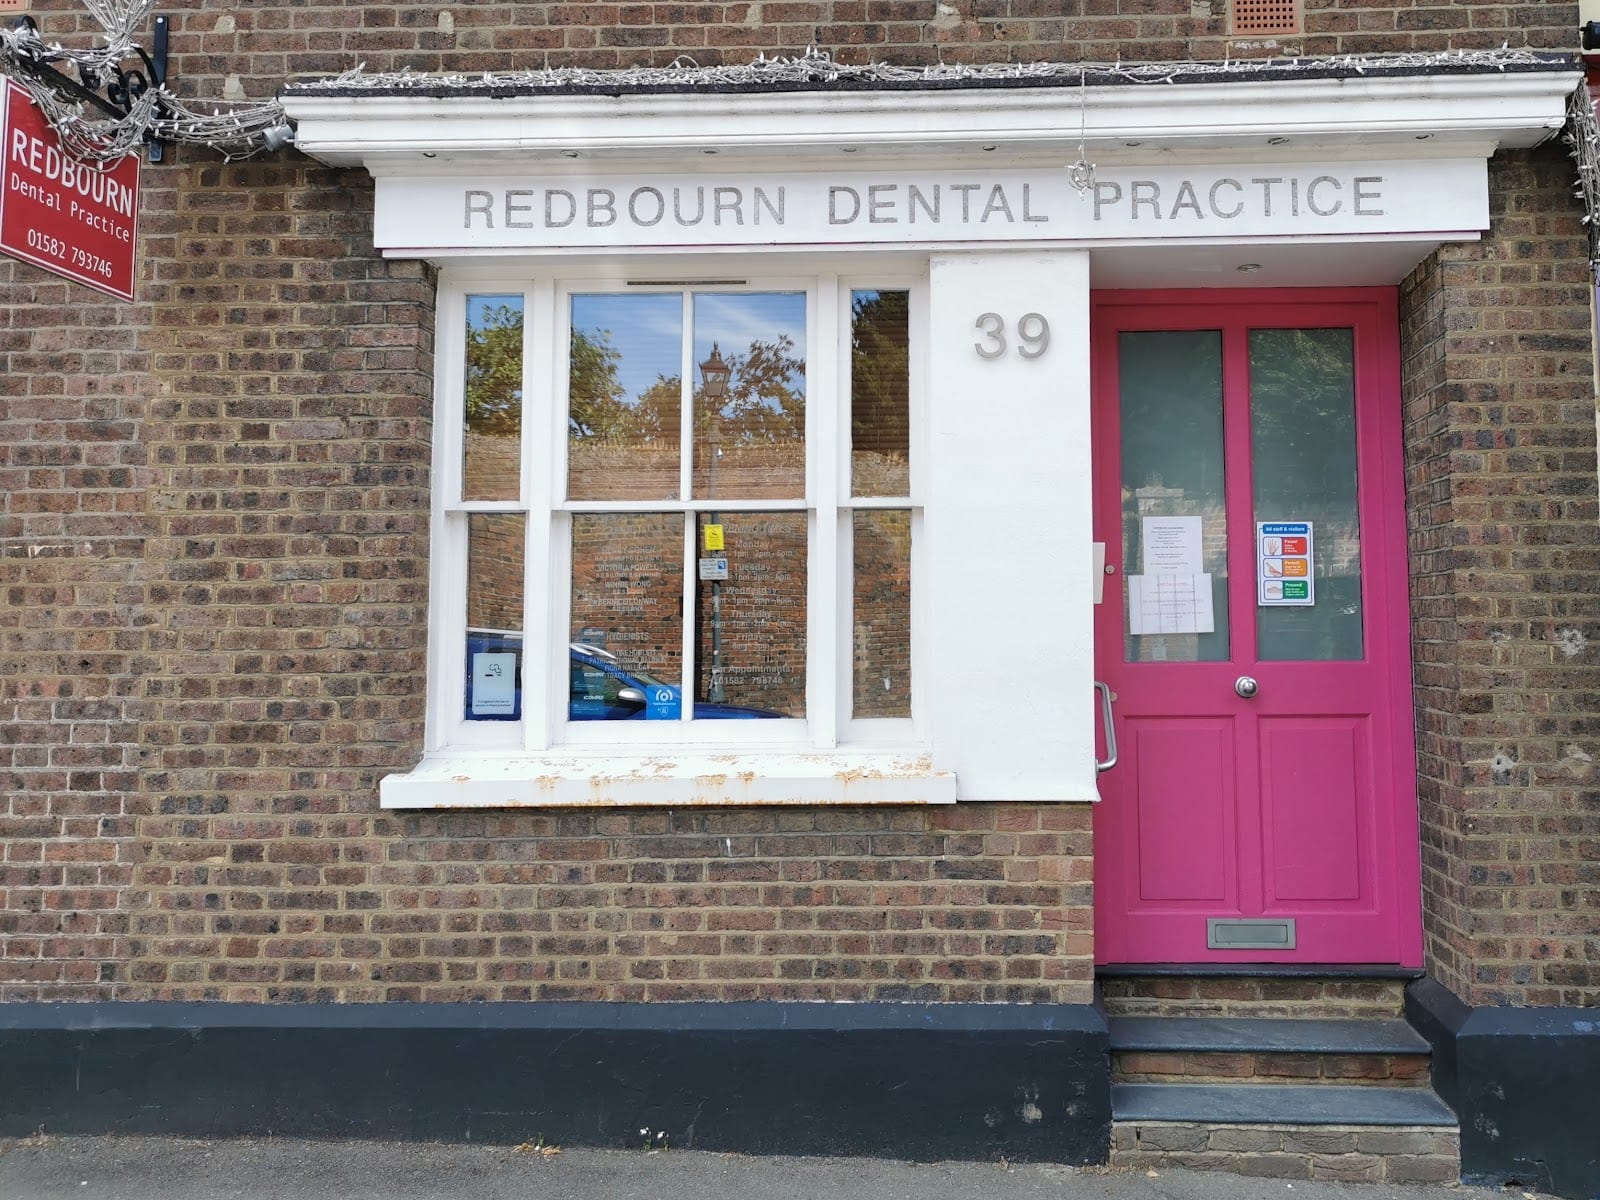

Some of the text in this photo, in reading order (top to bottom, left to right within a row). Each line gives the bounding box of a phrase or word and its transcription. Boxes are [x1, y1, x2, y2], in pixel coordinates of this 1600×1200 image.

[12, 128, 133, 217] REDBOURN
[11, 172, 130, 243] Dental Practice
[464, 176, 1385, 229] REDBOURN DENTAL PRACTICE
[27, 228, 113, 279] 01582 793746
[974, 312, 1051, 360] 39
[734, 540, 770, 550] Monday
[734, 563, 771, 573] Tuesday
[725, 586, 778, 595] Wednesday
[731, 609, 772, 619] Thursday
[606, 631, 650, 641] HYGIENISTS
[735, 632, 765, 642] Friday
[728, 664, 791, 675] Appointments
